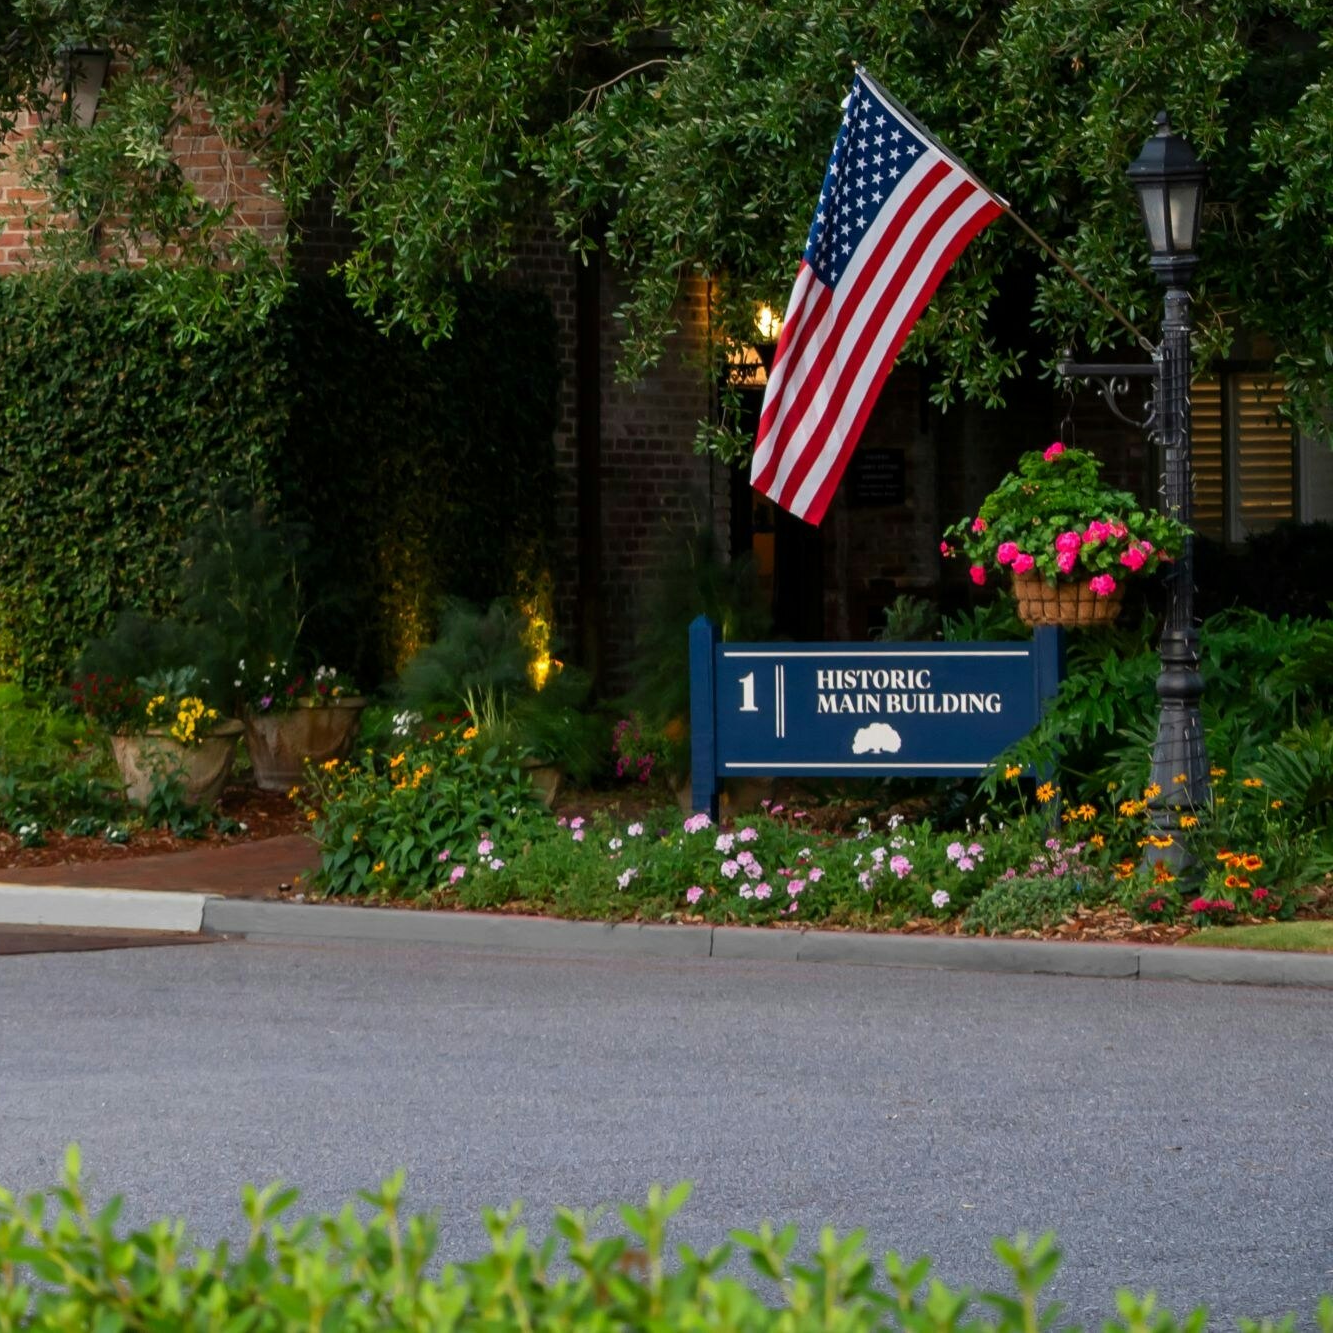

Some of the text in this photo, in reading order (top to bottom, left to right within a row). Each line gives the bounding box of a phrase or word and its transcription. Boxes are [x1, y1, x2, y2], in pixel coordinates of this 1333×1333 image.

[817, 669, 930, 690] HISTORIC
[738, 671, 759, 712] 1
[817, 693, 1001, 714] MAIN BUILDING
